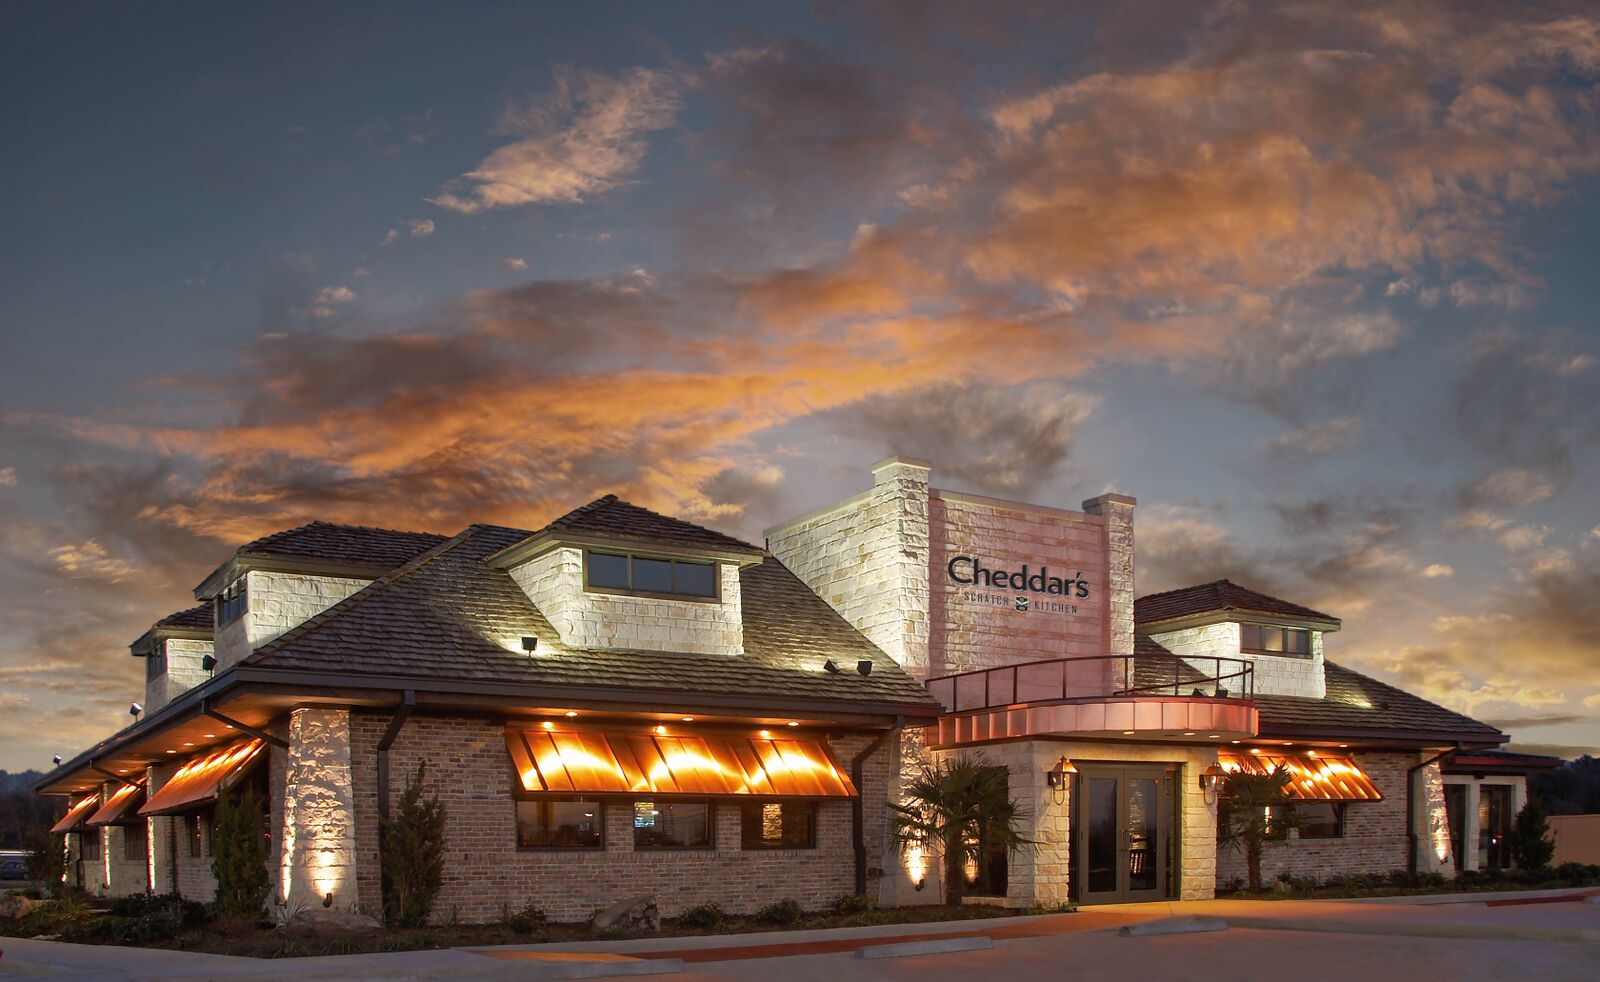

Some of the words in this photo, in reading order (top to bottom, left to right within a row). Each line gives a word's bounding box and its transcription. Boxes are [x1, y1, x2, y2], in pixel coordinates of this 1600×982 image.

[948, 556, 1089, 598] Cheddar's
[964, 591, 1009, 606] SCRATCH
[1034, 602, 1077, 614] KITCHEN
